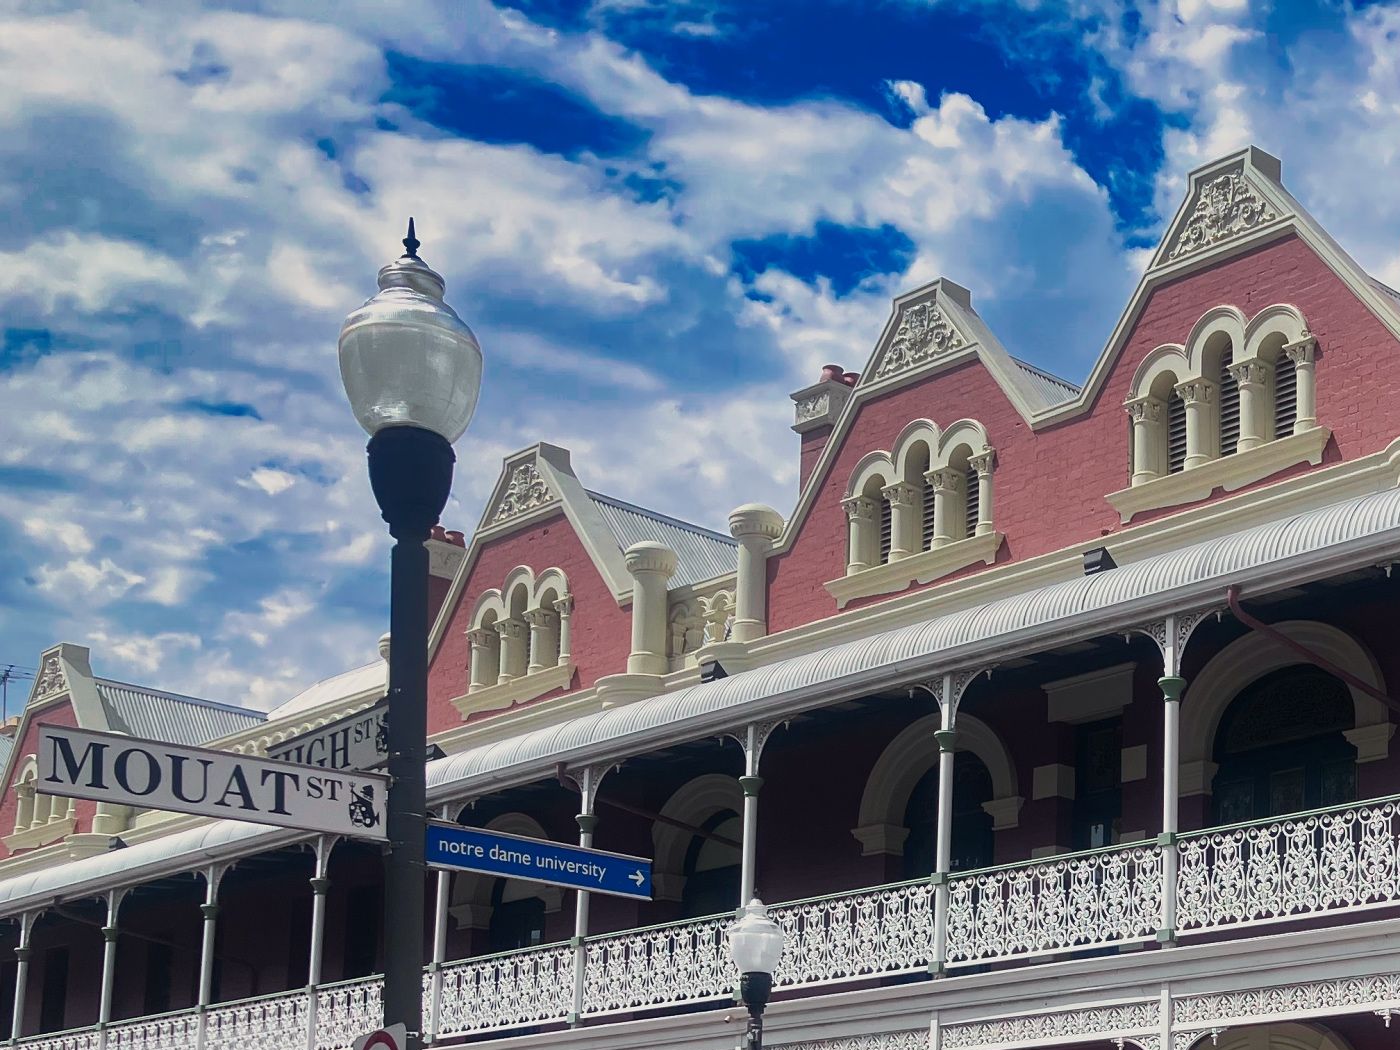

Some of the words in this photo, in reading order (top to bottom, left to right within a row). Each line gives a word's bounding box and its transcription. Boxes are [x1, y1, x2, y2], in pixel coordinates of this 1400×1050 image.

[270, 726, 352, 770] IGH
[354, 718, 373, 744] ST
[45, 735, 300, 816] MOUAT
[306, 776, 343, 801] ST
[439, 839, 484, 858] notre
[489, 844, 531, 866] dame
[536, 856, 606, 882] university
